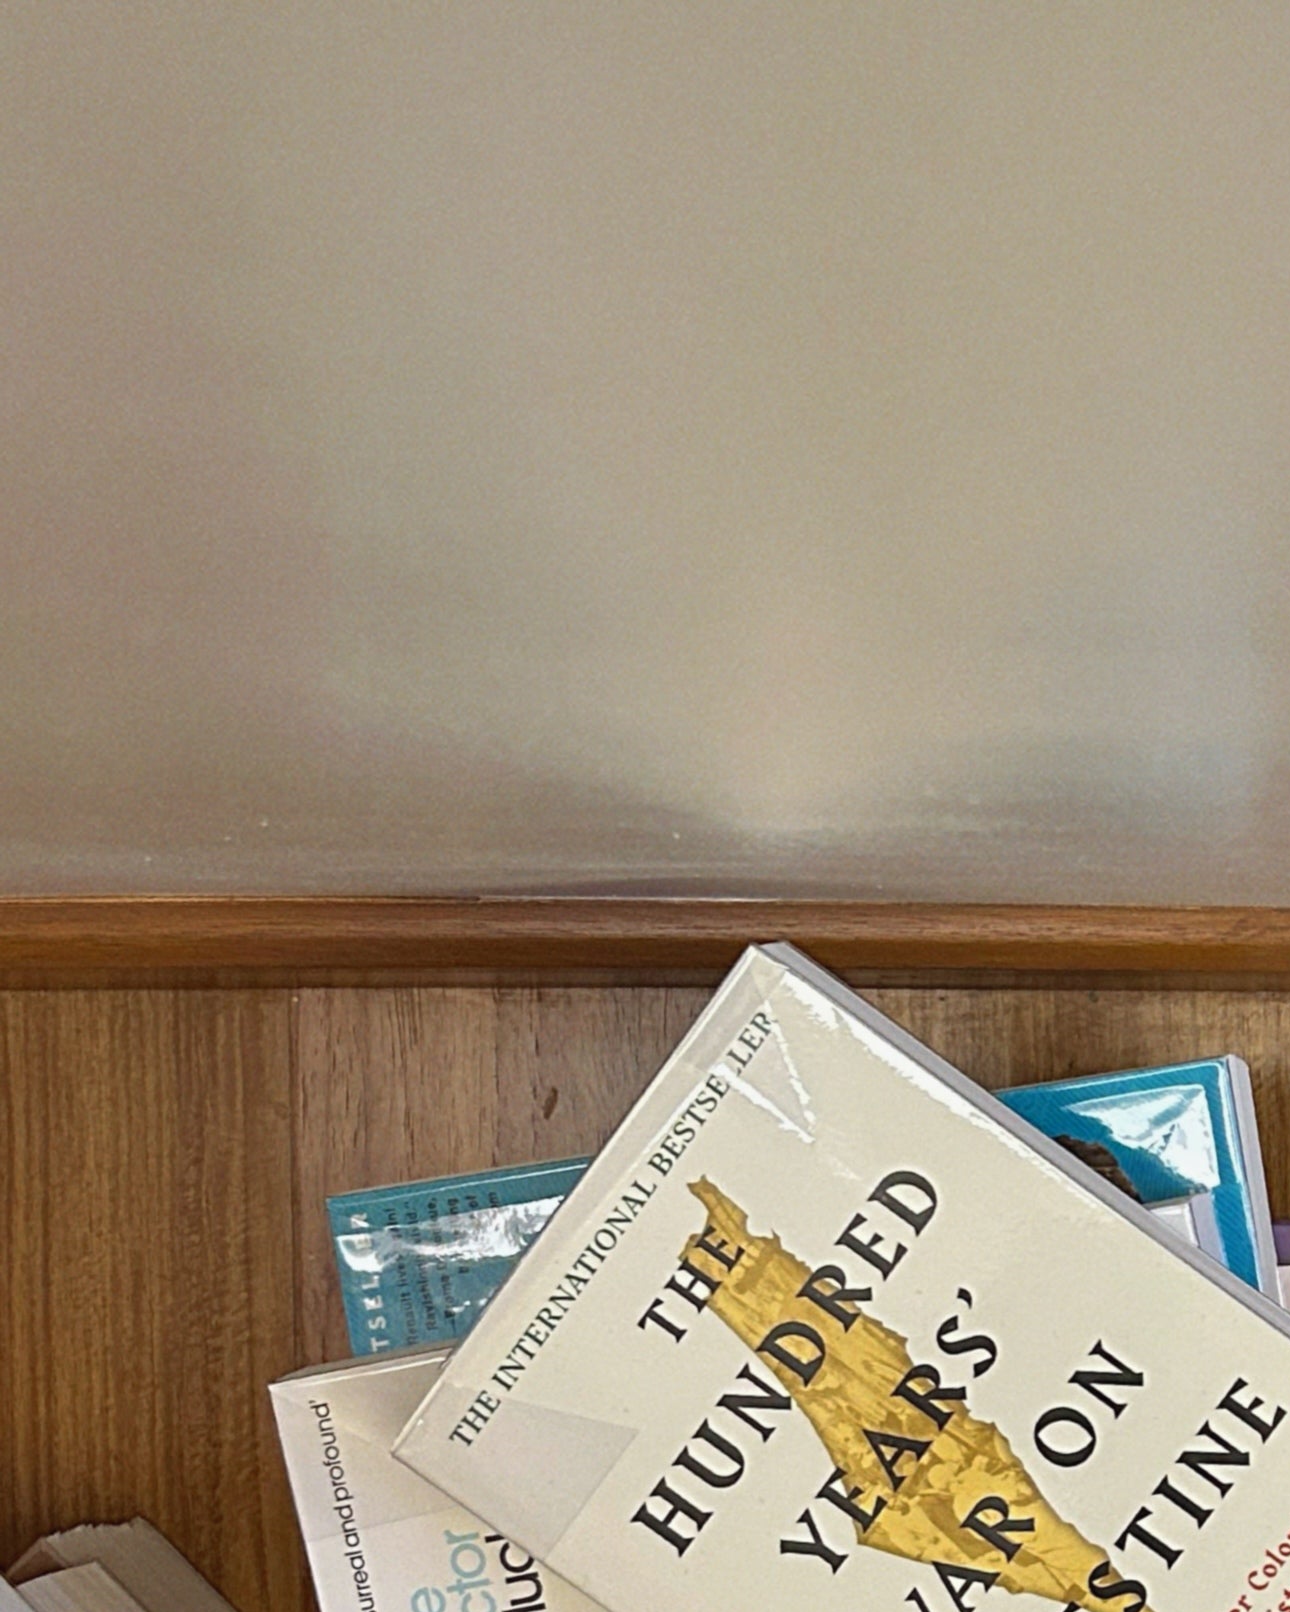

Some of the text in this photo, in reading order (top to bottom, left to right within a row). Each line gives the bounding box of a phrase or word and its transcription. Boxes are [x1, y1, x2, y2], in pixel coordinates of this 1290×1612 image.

[448, 1010, 778, 1447] THE INTERNATIONAL BESTSELER
[637, 1225, 745, 1344] THE
[630, 1170, 938, 1558] HUNDRED
[1033, 1338, 1144, 1468] ON
[334, 1505, 360, 1547] and
